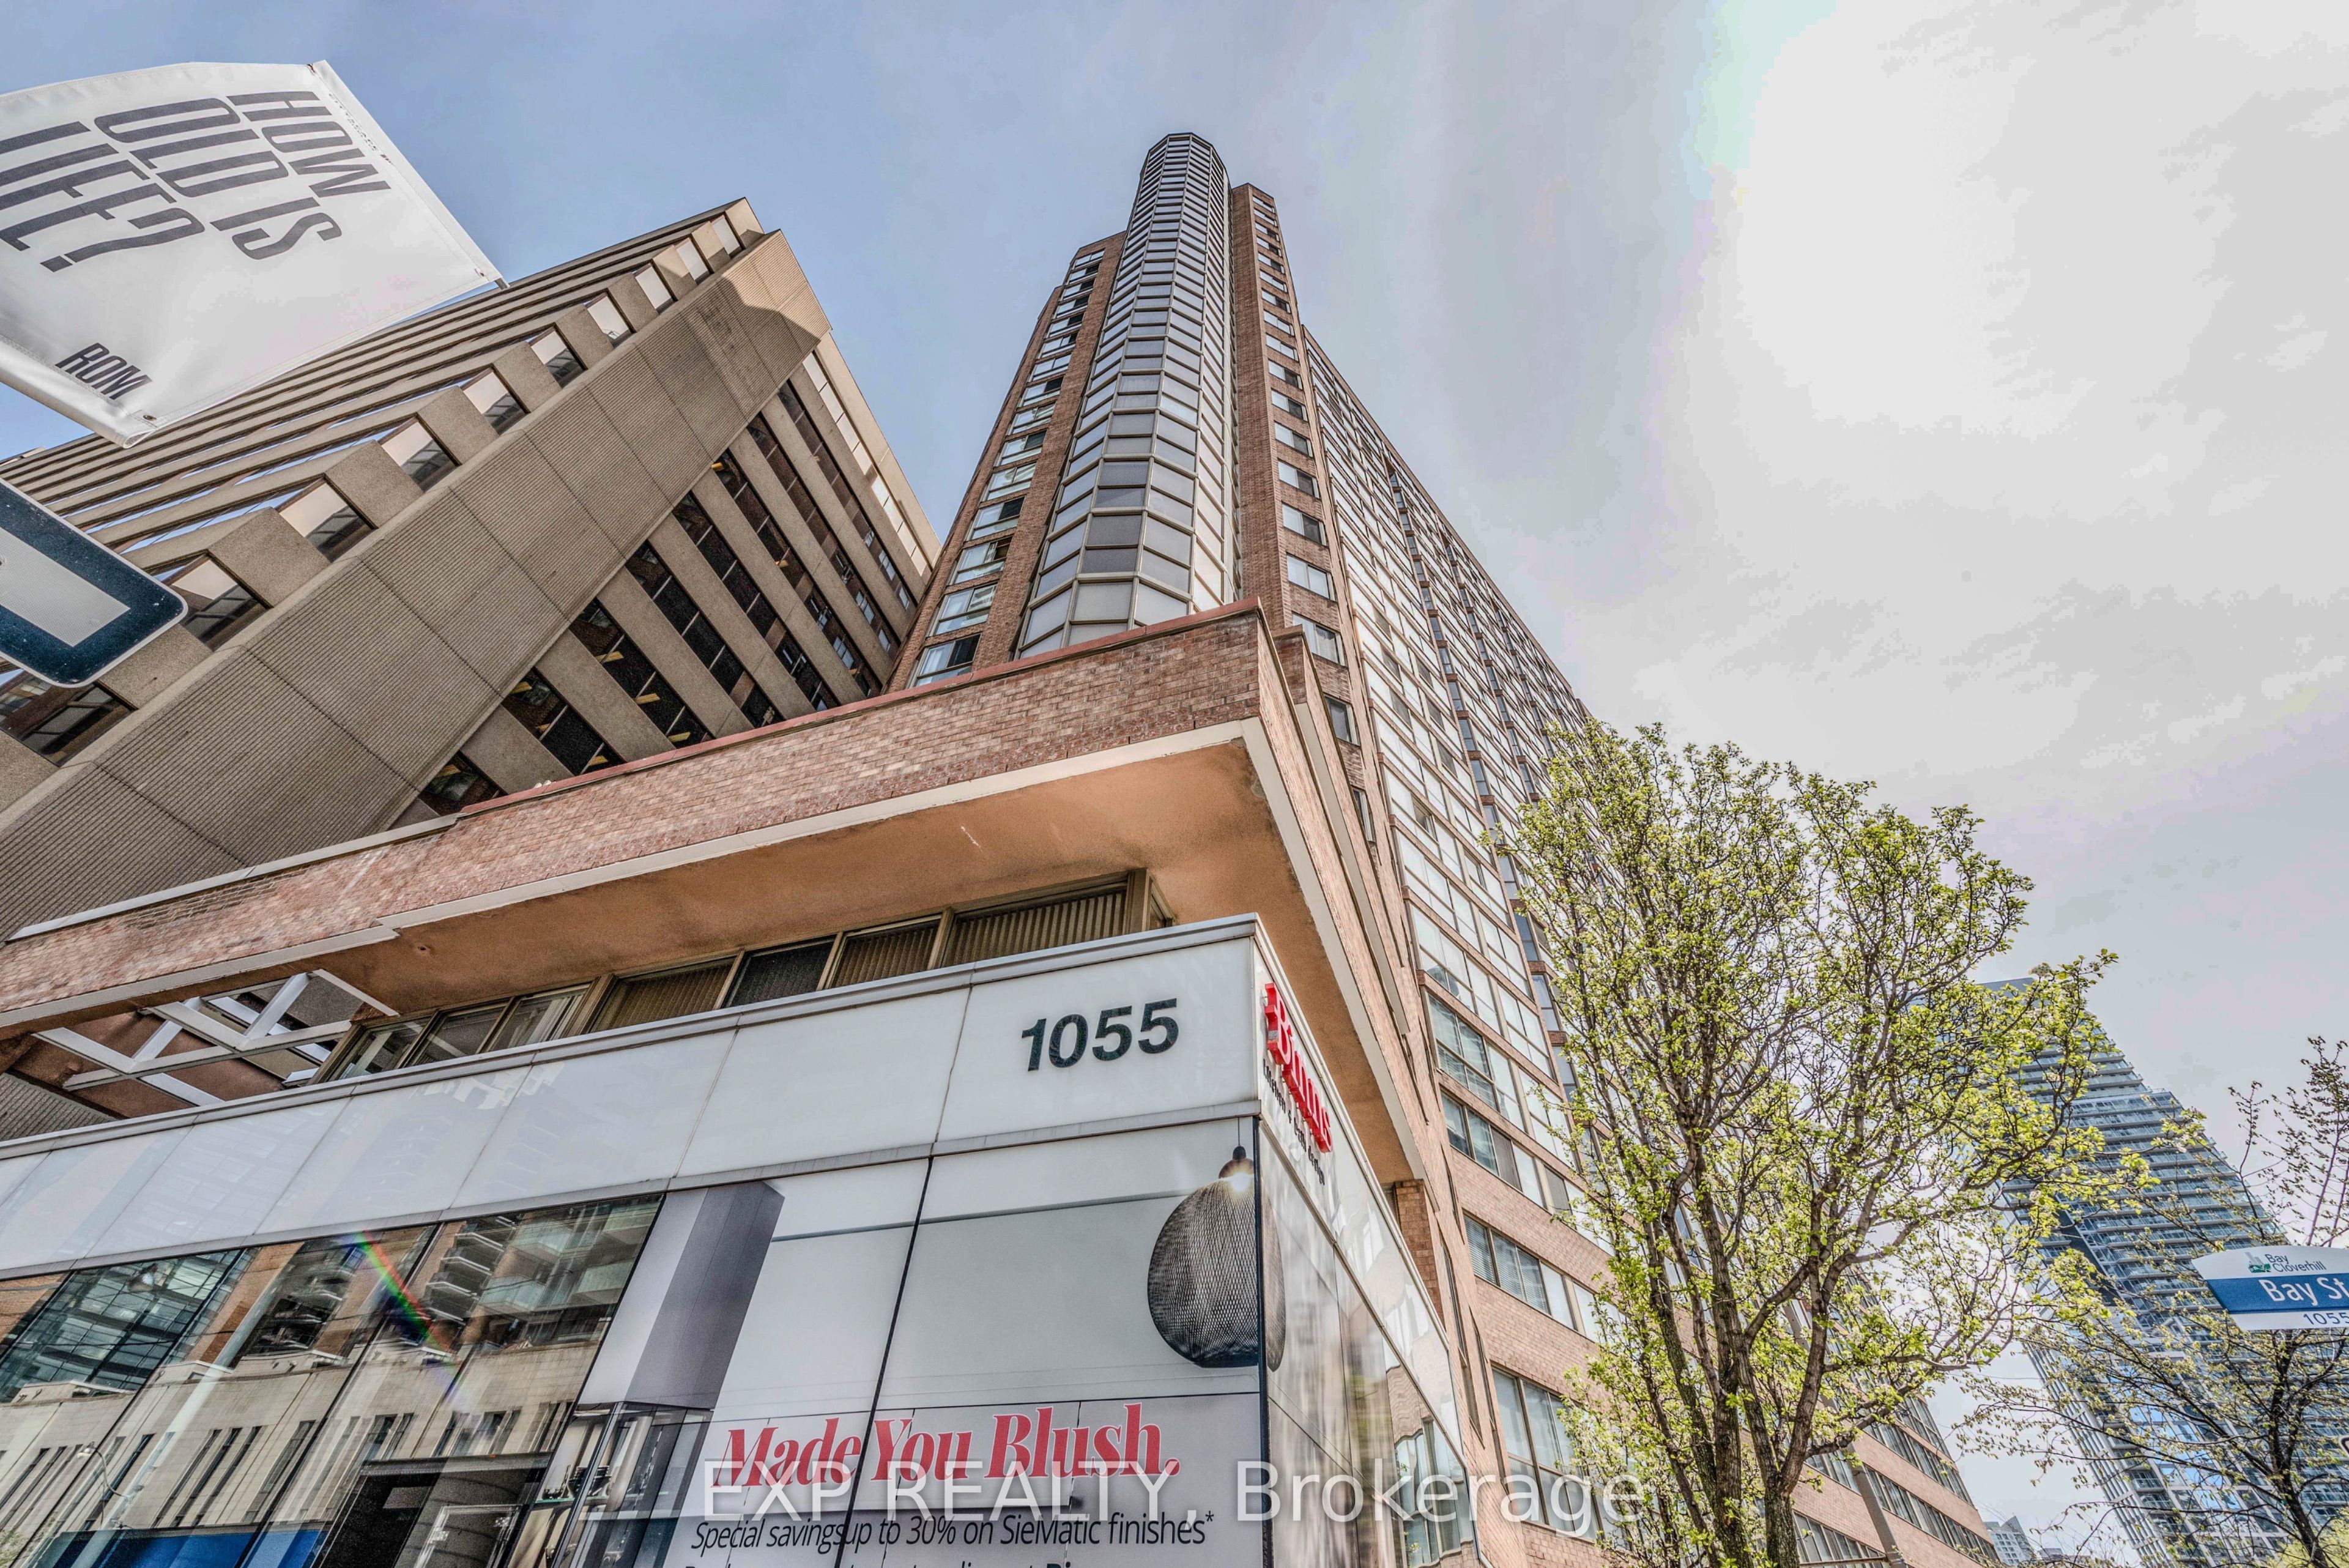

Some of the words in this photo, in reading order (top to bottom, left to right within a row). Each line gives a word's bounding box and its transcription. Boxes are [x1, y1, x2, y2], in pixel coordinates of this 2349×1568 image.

[226, 91, 391, 198] HOW
[94, 98, 289, 198] OLD
[210, 197, 343, 260] IS
[55, 343, 152, 400] ROM
[1021, 998, 1179, 1072] 1055
[1264, 982, 1333, 1154] Binns
[2258, 1279, 2318, 1306] Bay
[2317, 1277, 2349, 1299] St
[2265, 1254, 2289, 1265] Bay
[2273, 1260, 2327, 1273] Cloverhill
[711, 1417, 862, 1487] Made
[870, 1417, 974, 1481] You
[984, 1403, 1181, 1481] Blush.
[691, 1518, 766, 1557] Special
[879, 1520, 901, 1545] to
[907, 1516, 957, 1545] 30%
[963, 1522, 993, 1545] on
[1000, 1512, 1101, 1545] SieMatic
